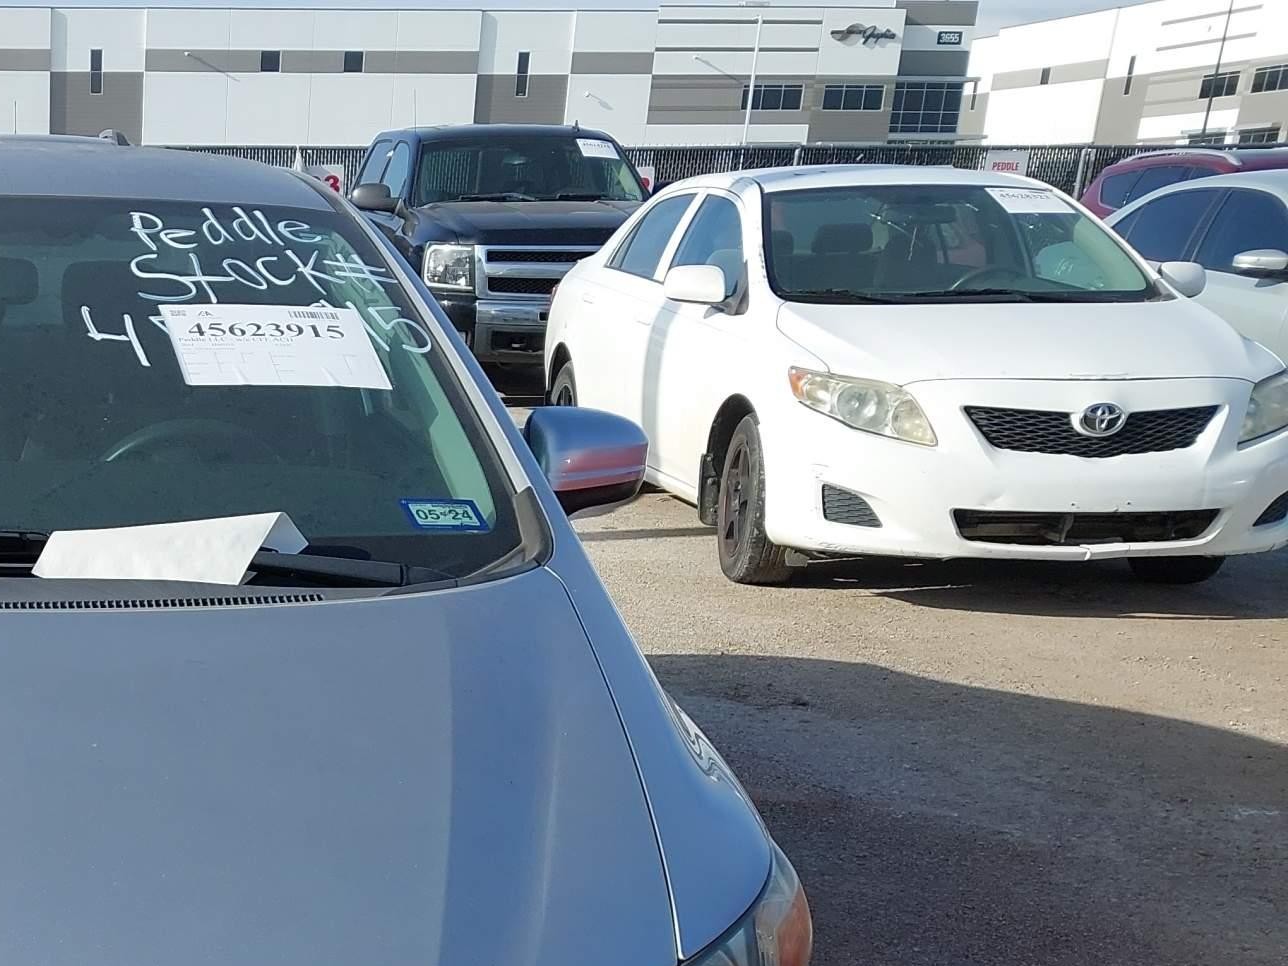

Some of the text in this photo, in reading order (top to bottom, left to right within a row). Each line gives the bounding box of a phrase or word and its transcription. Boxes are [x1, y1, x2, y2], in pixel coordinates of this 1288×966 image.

[992, 162, 1020, 171] PEDDLE
[129, 207, 321, 250] Peddle
[188, 322, 345, 339] 45623915
